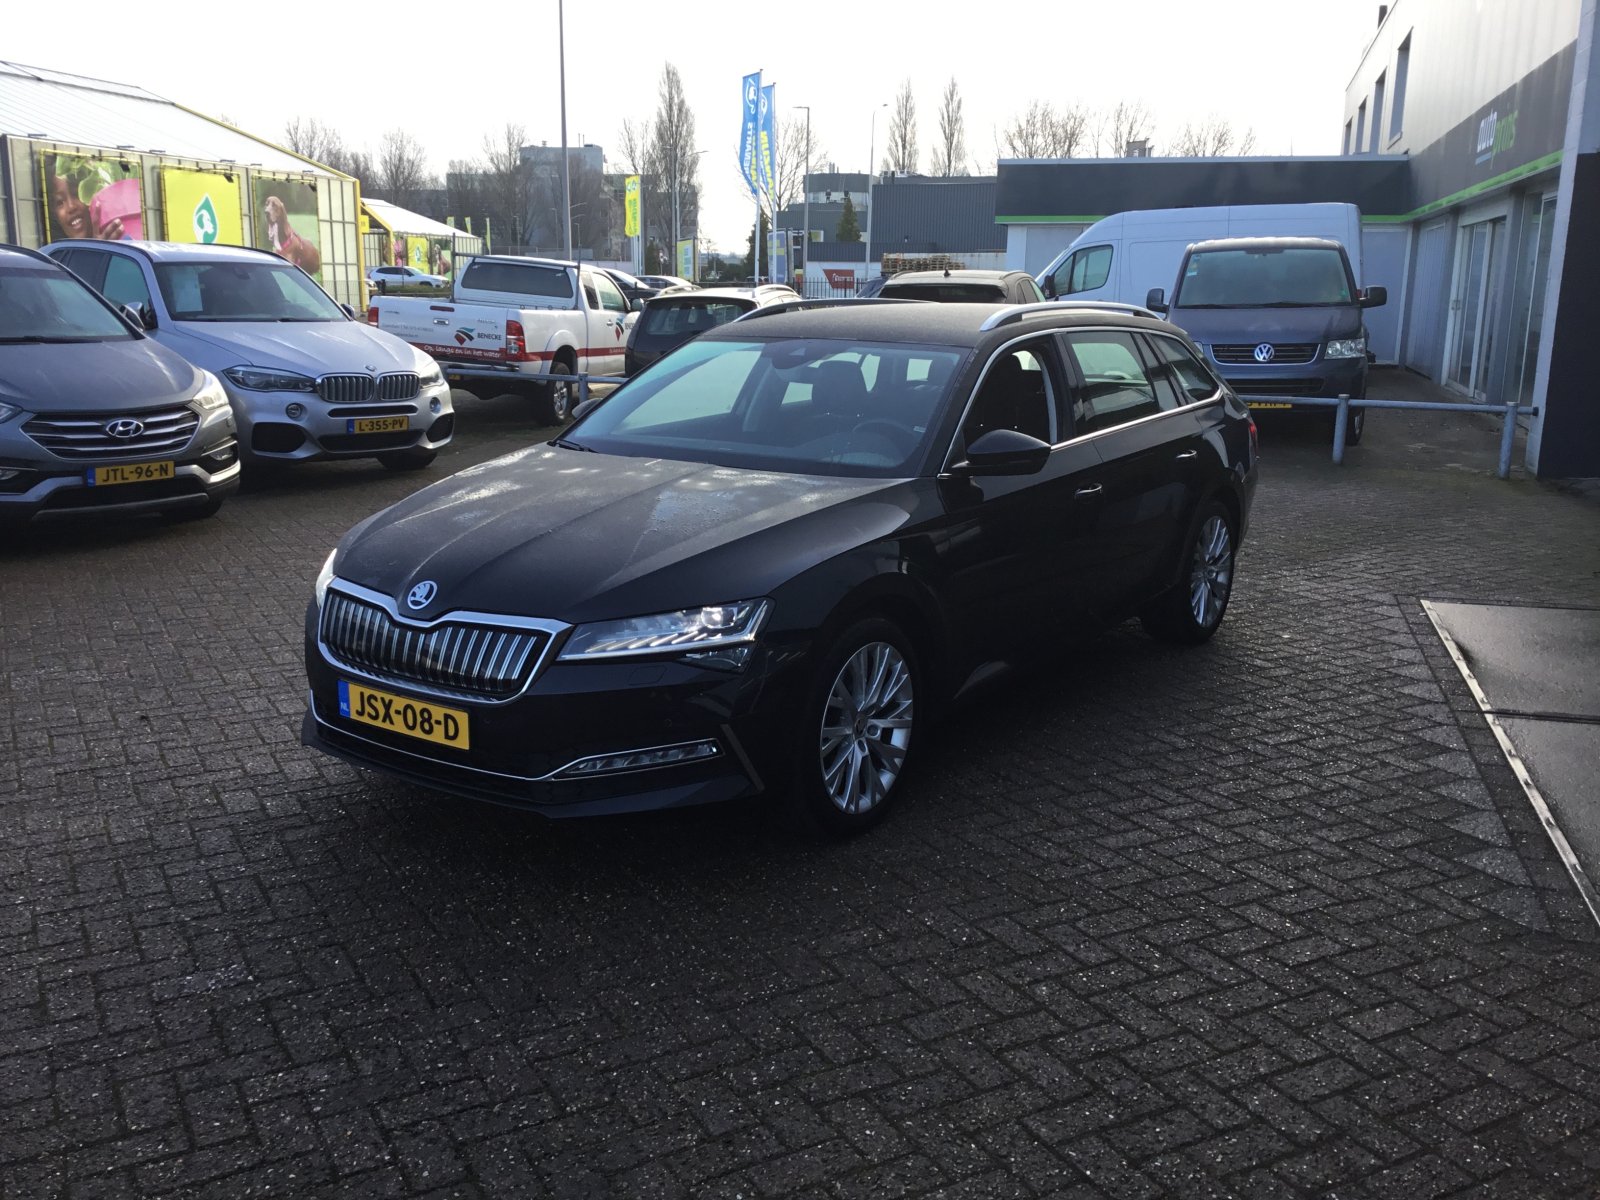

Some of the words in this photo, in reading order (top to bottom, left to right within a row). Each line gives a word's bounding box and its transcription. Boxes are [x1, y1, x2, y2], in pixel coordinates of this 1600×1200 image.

[477, 332, 502, 341] BENECKE
[358, 418, 405, 432] L-355-PV
[102, 463, 169, 483] JTL-96-N
[355, 691, 460, 741] JSX-08-D
